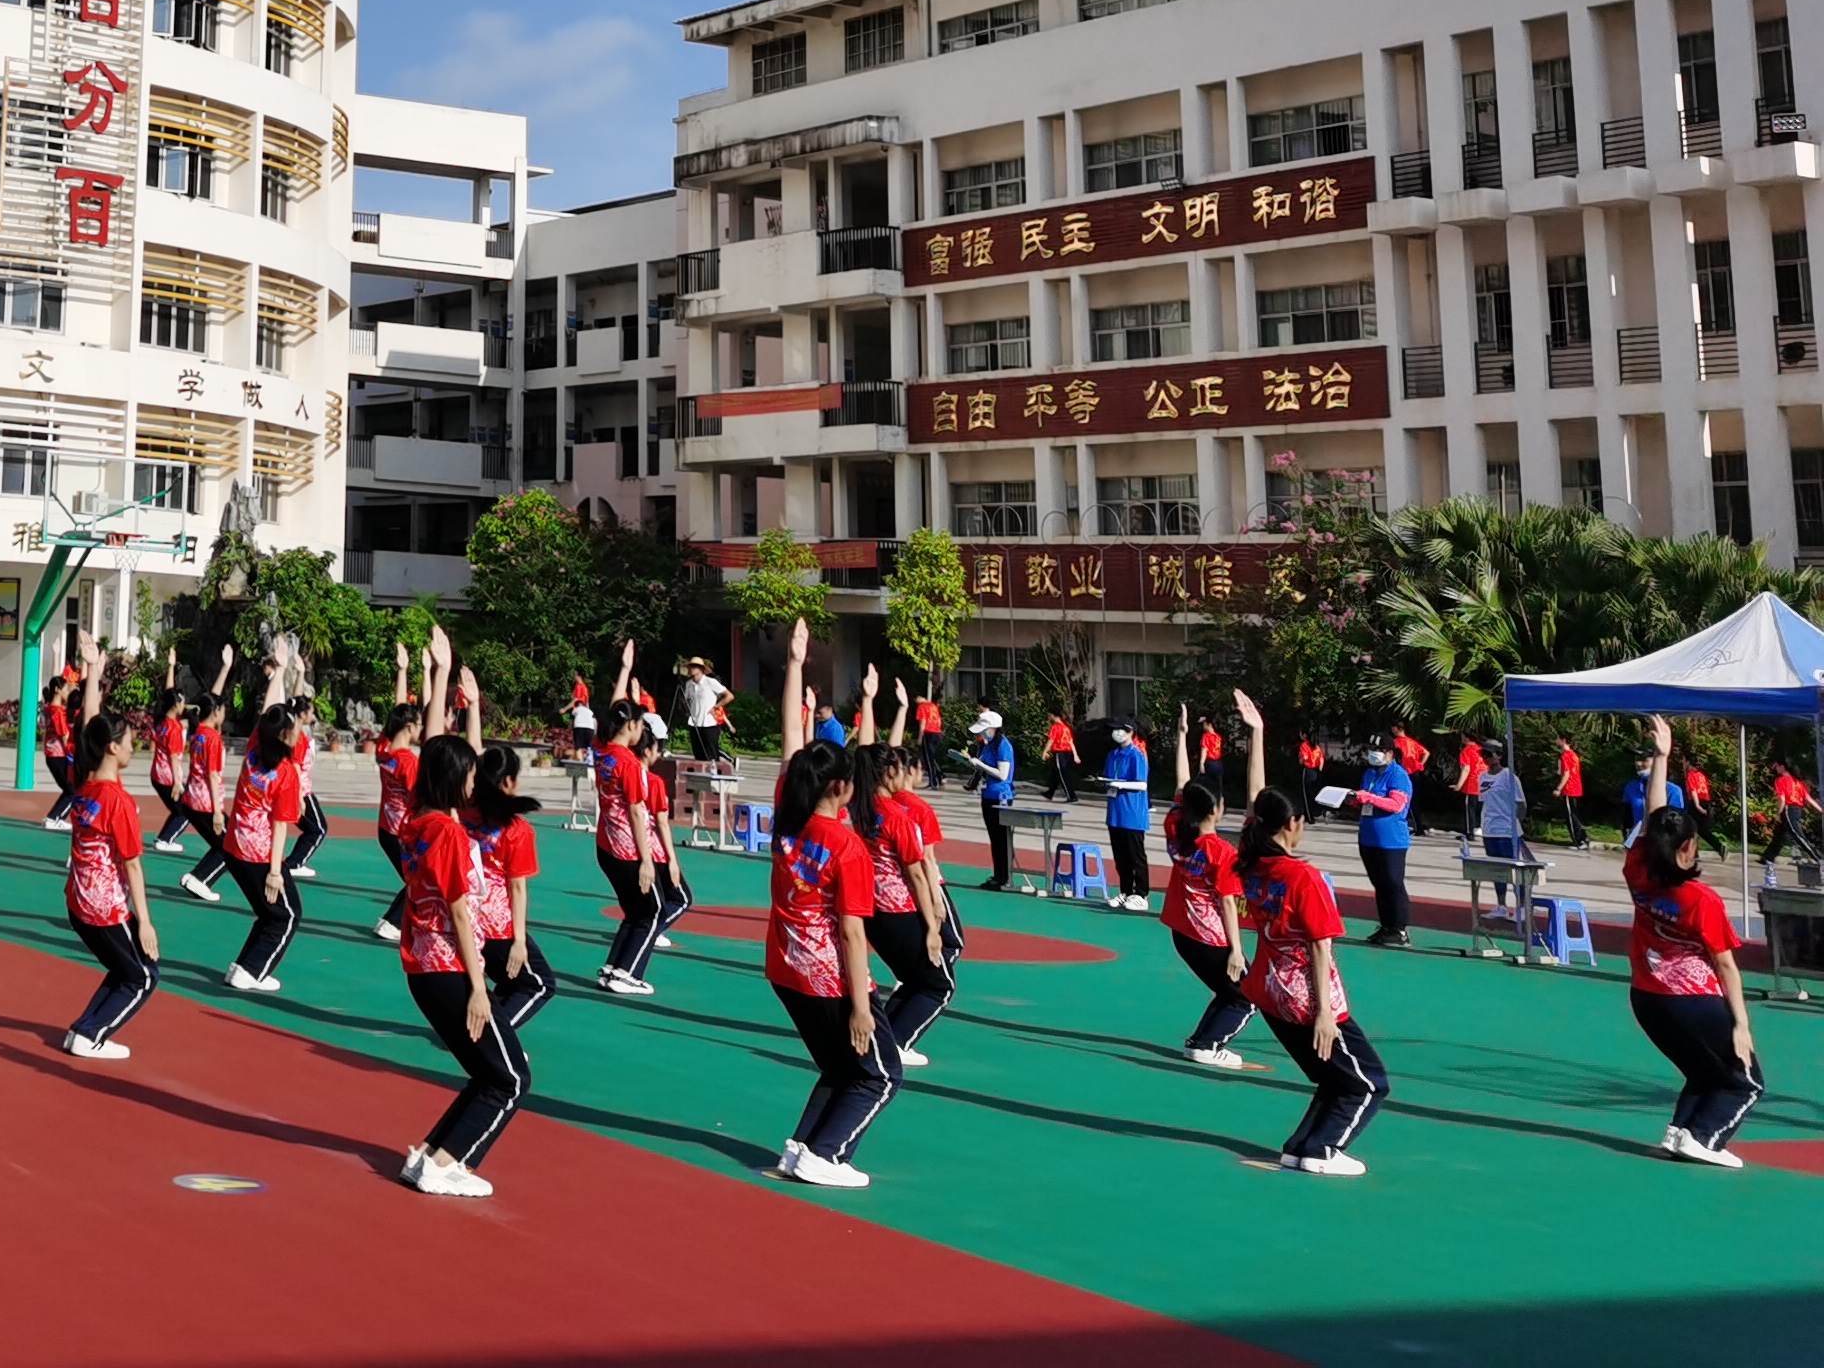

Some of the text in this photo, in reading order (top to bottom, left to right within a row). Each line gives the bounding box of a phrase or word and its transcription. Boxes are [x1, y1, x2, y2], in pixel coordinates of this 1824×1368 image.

[926, 175, 1341, 276] 富强 民主 文明 和谐
[931, 361, 1353, 433] 自由 平等 公正 法治
[1026, 553, 1106, 599] 敬业
[1148, 554, 1233, 600] 诚信
